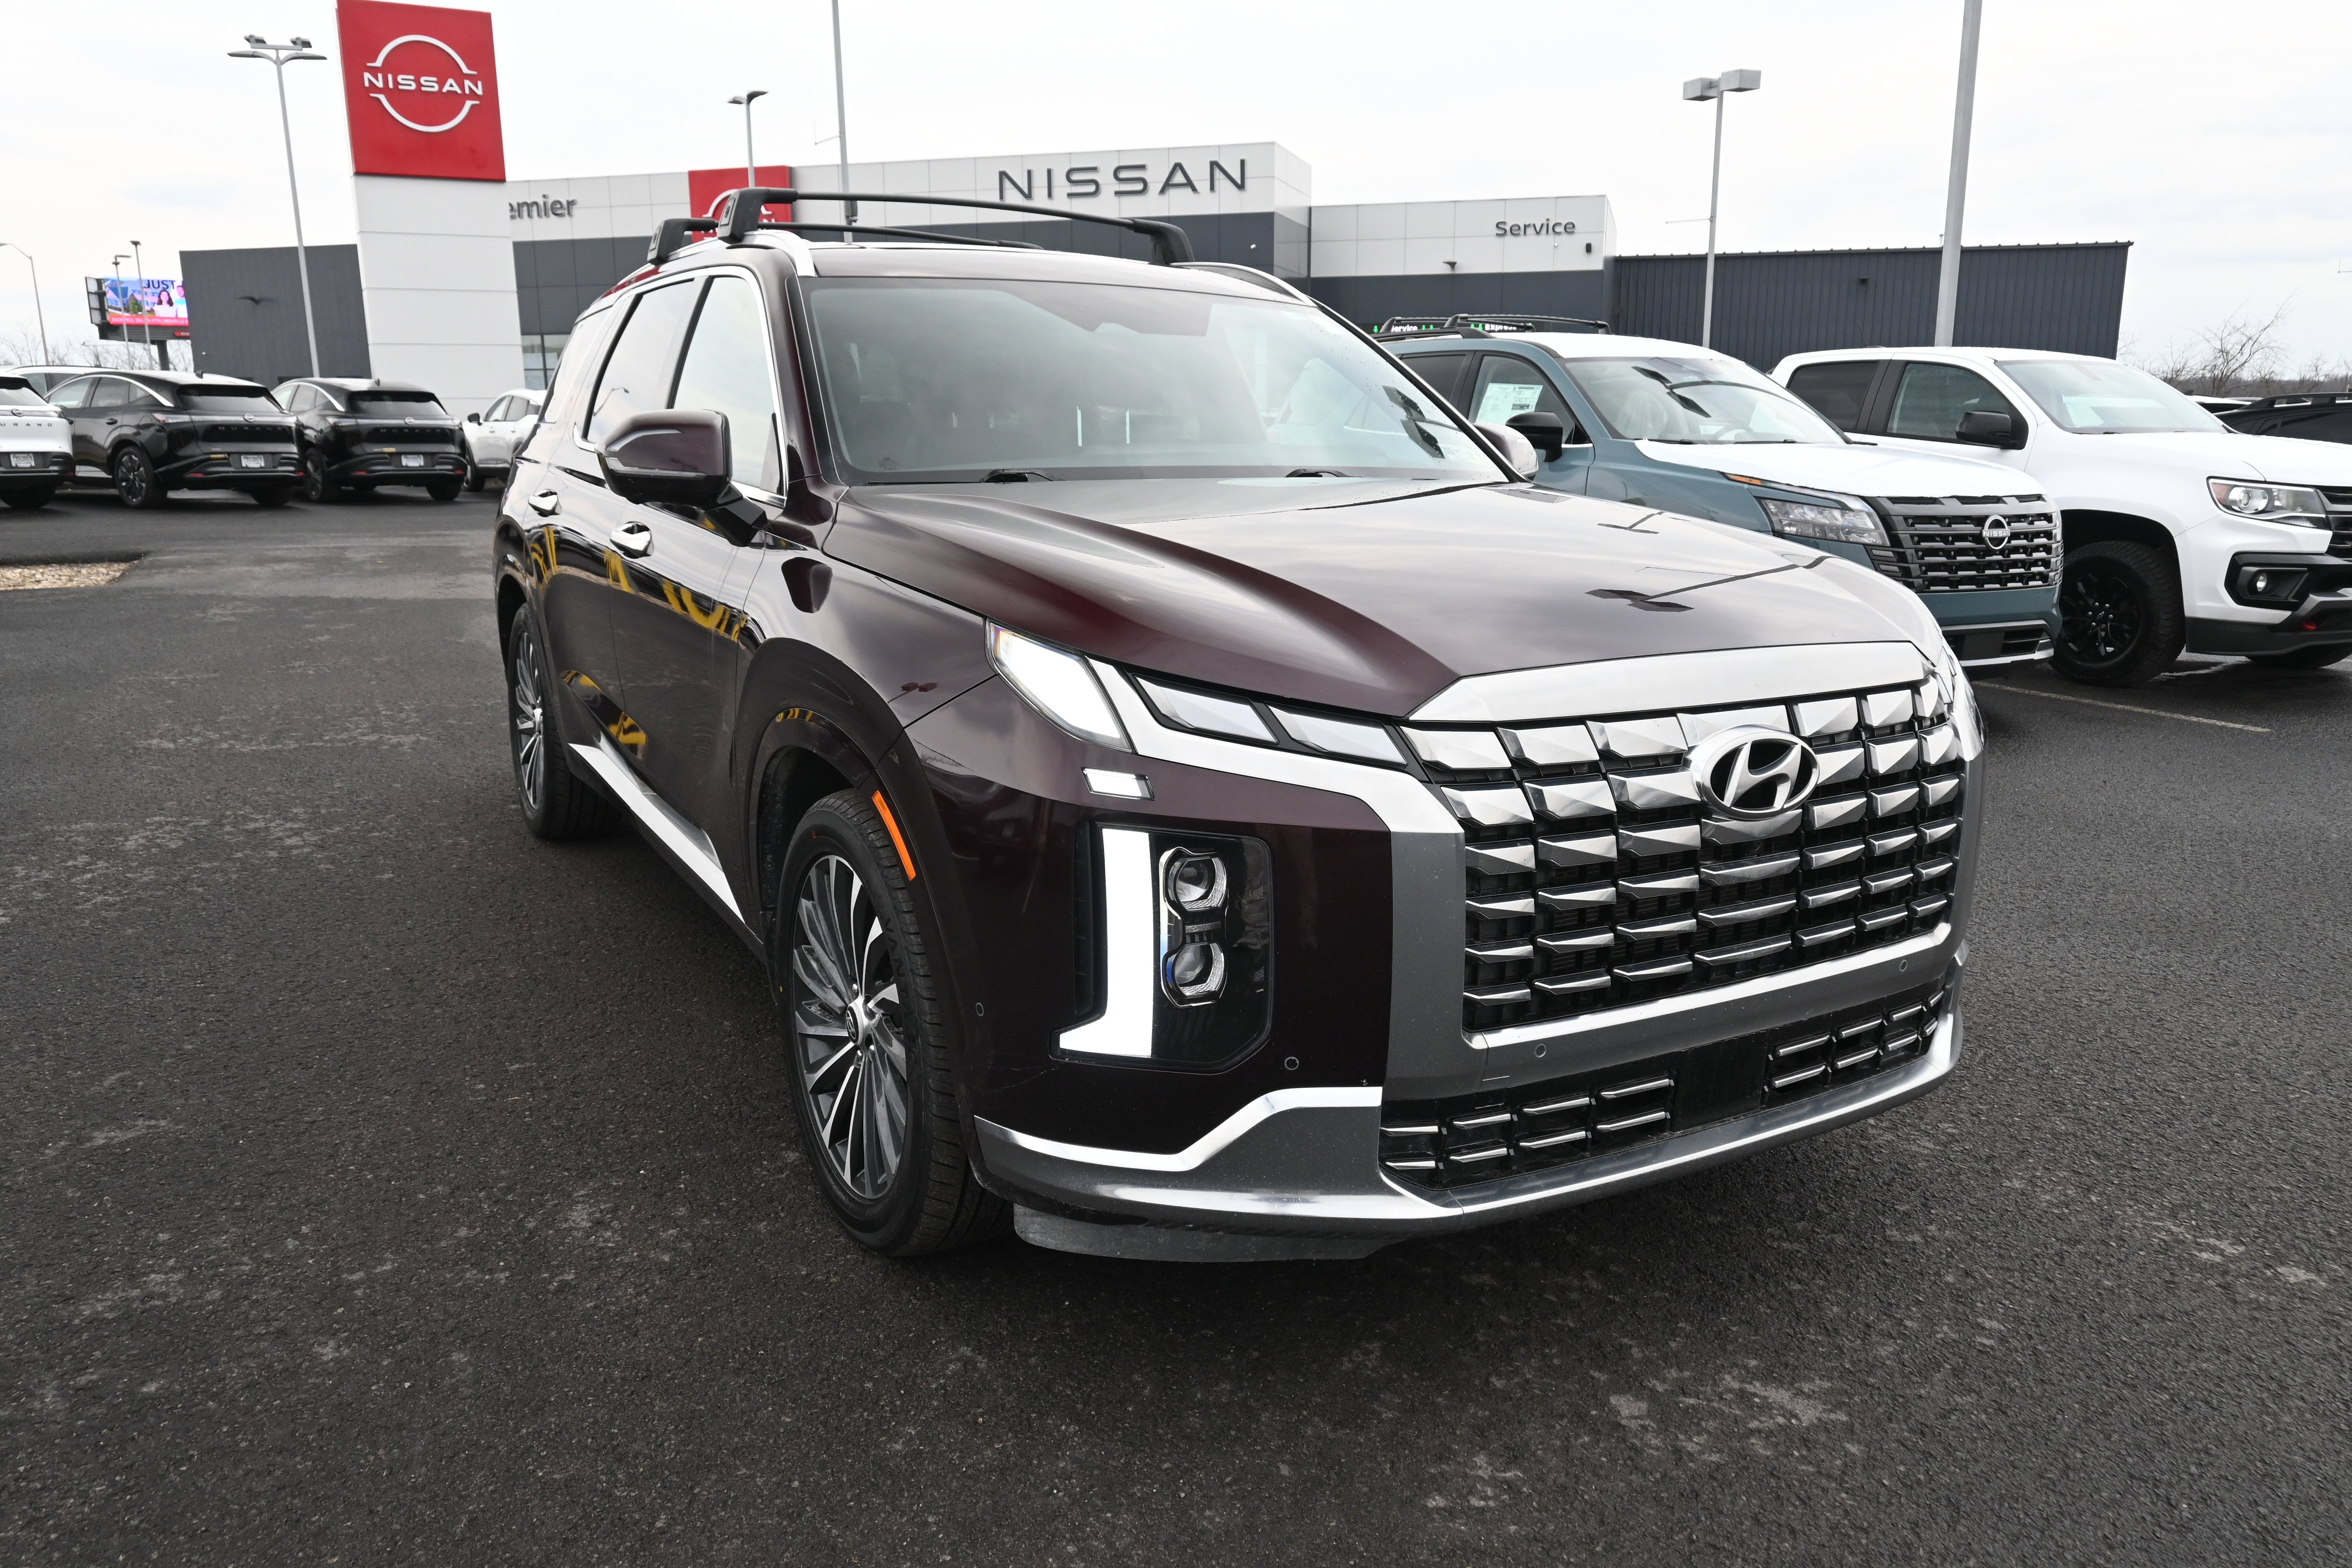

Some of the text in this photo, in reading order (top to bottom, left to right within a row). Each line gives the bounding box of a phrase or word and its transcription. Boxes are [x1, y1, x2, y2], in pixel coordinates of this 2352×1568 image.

[363, 72, 483, 95] NISSAN
[999, 158, 1246, 201] NISSAN
[1496, 218, 1576, 236] Service
[143, 279, 176, 289] JUST
